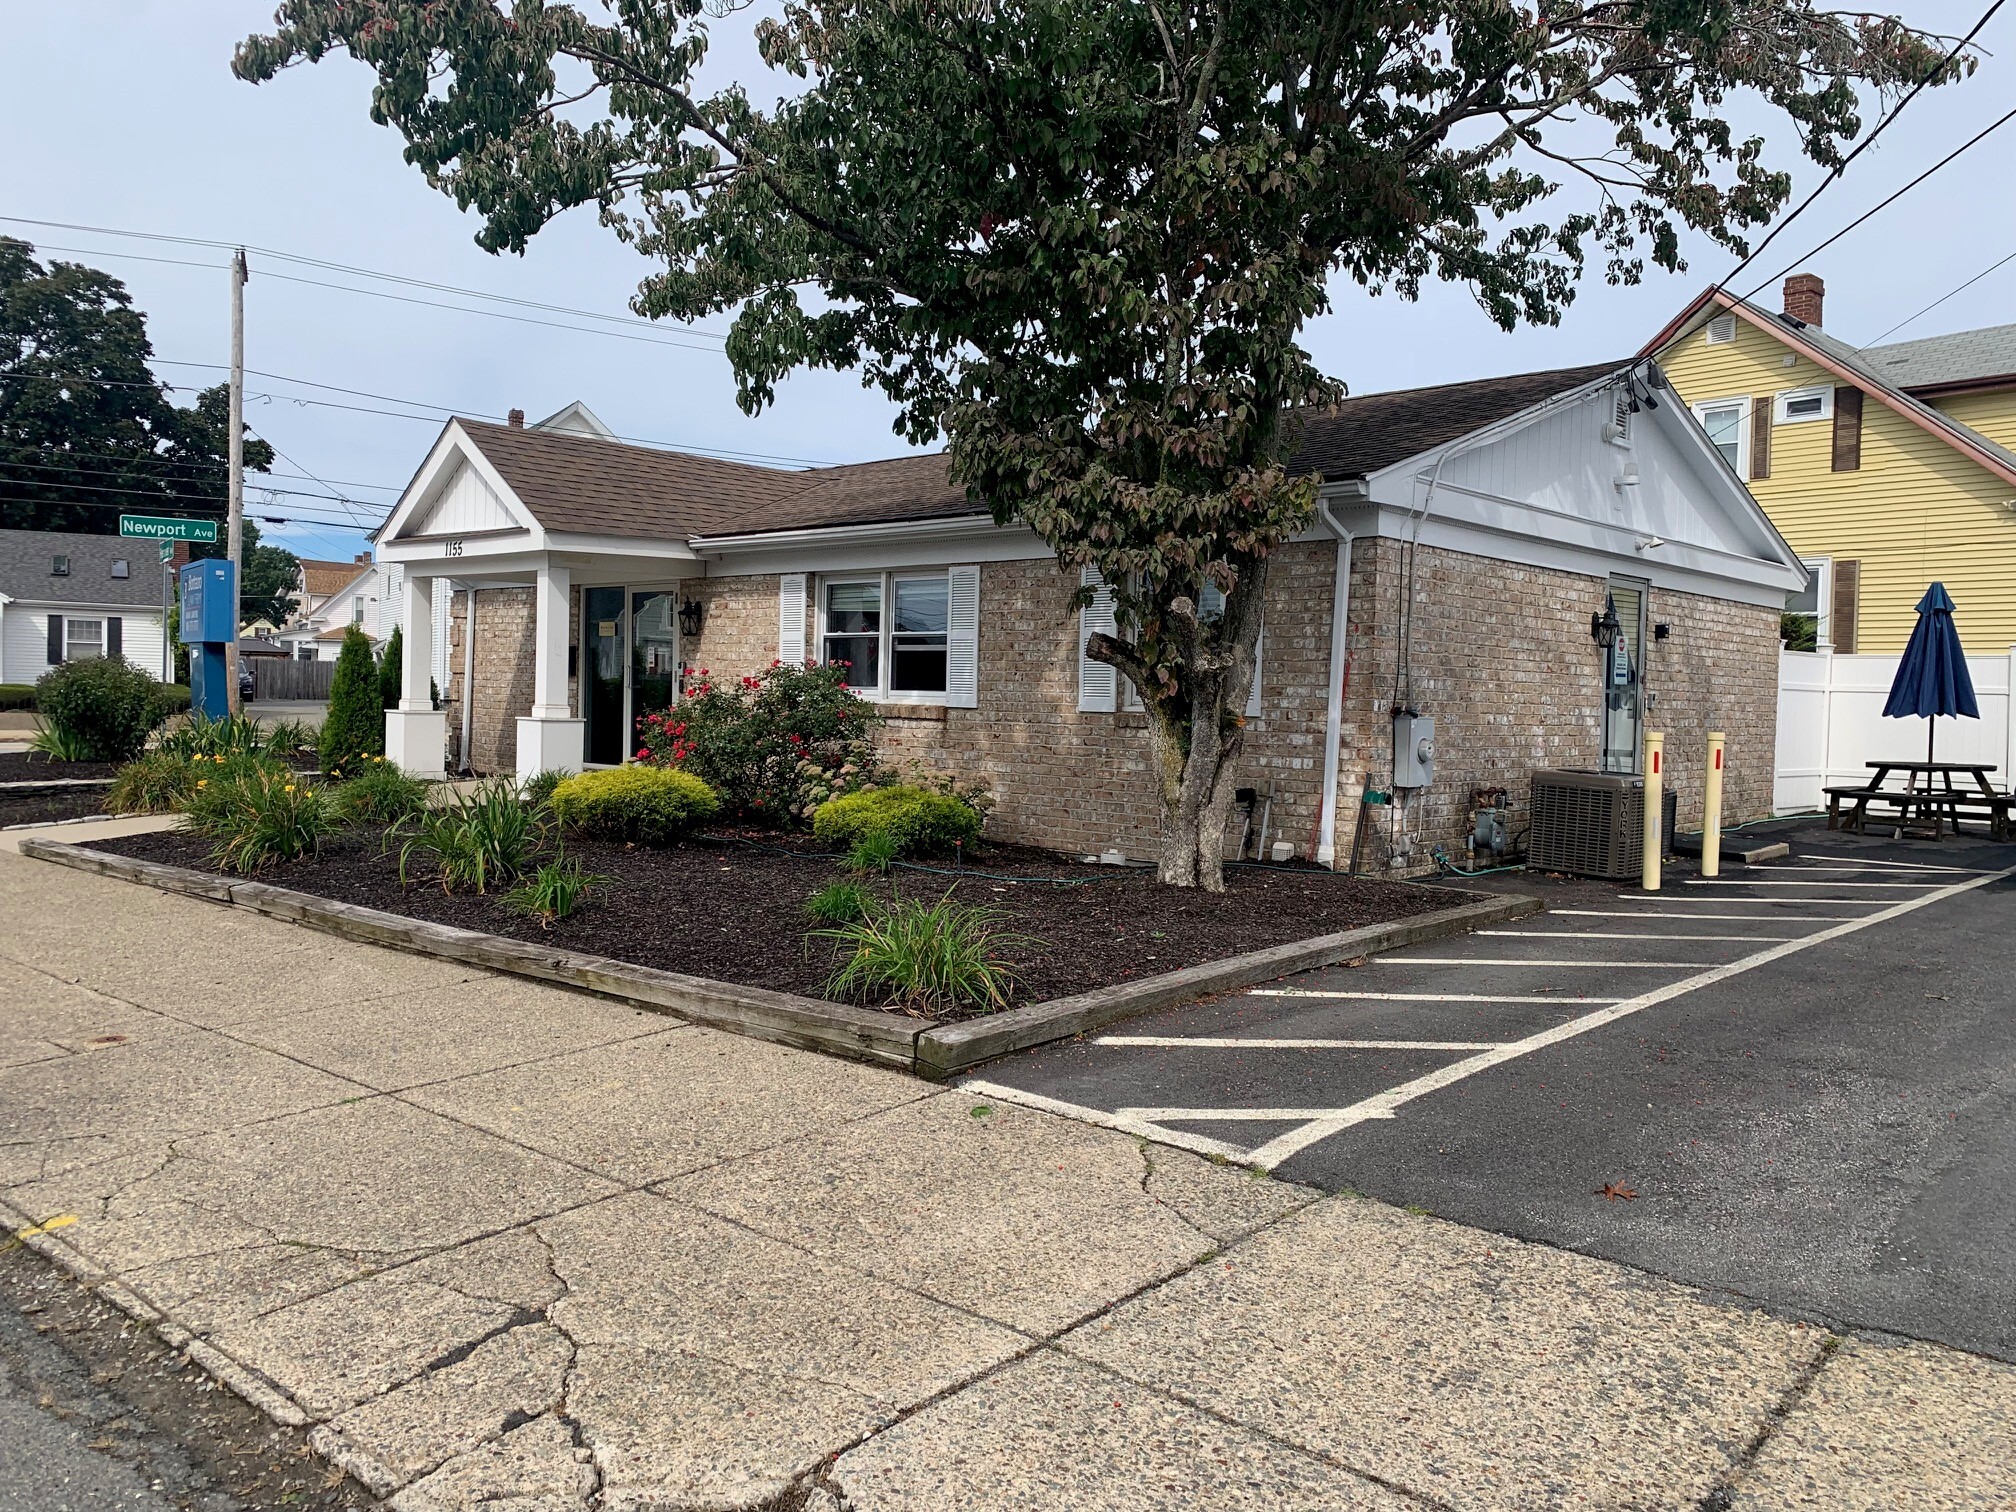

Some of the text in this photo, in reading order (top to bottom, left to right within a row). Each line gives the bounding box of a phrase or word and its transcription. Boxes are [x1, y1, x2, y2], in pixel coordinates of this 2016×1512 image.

[123, 520, 213, 538] Newport Ave
[445, 540, 463, 557] 1155
[1619, 800, 1629, 839] YORK
